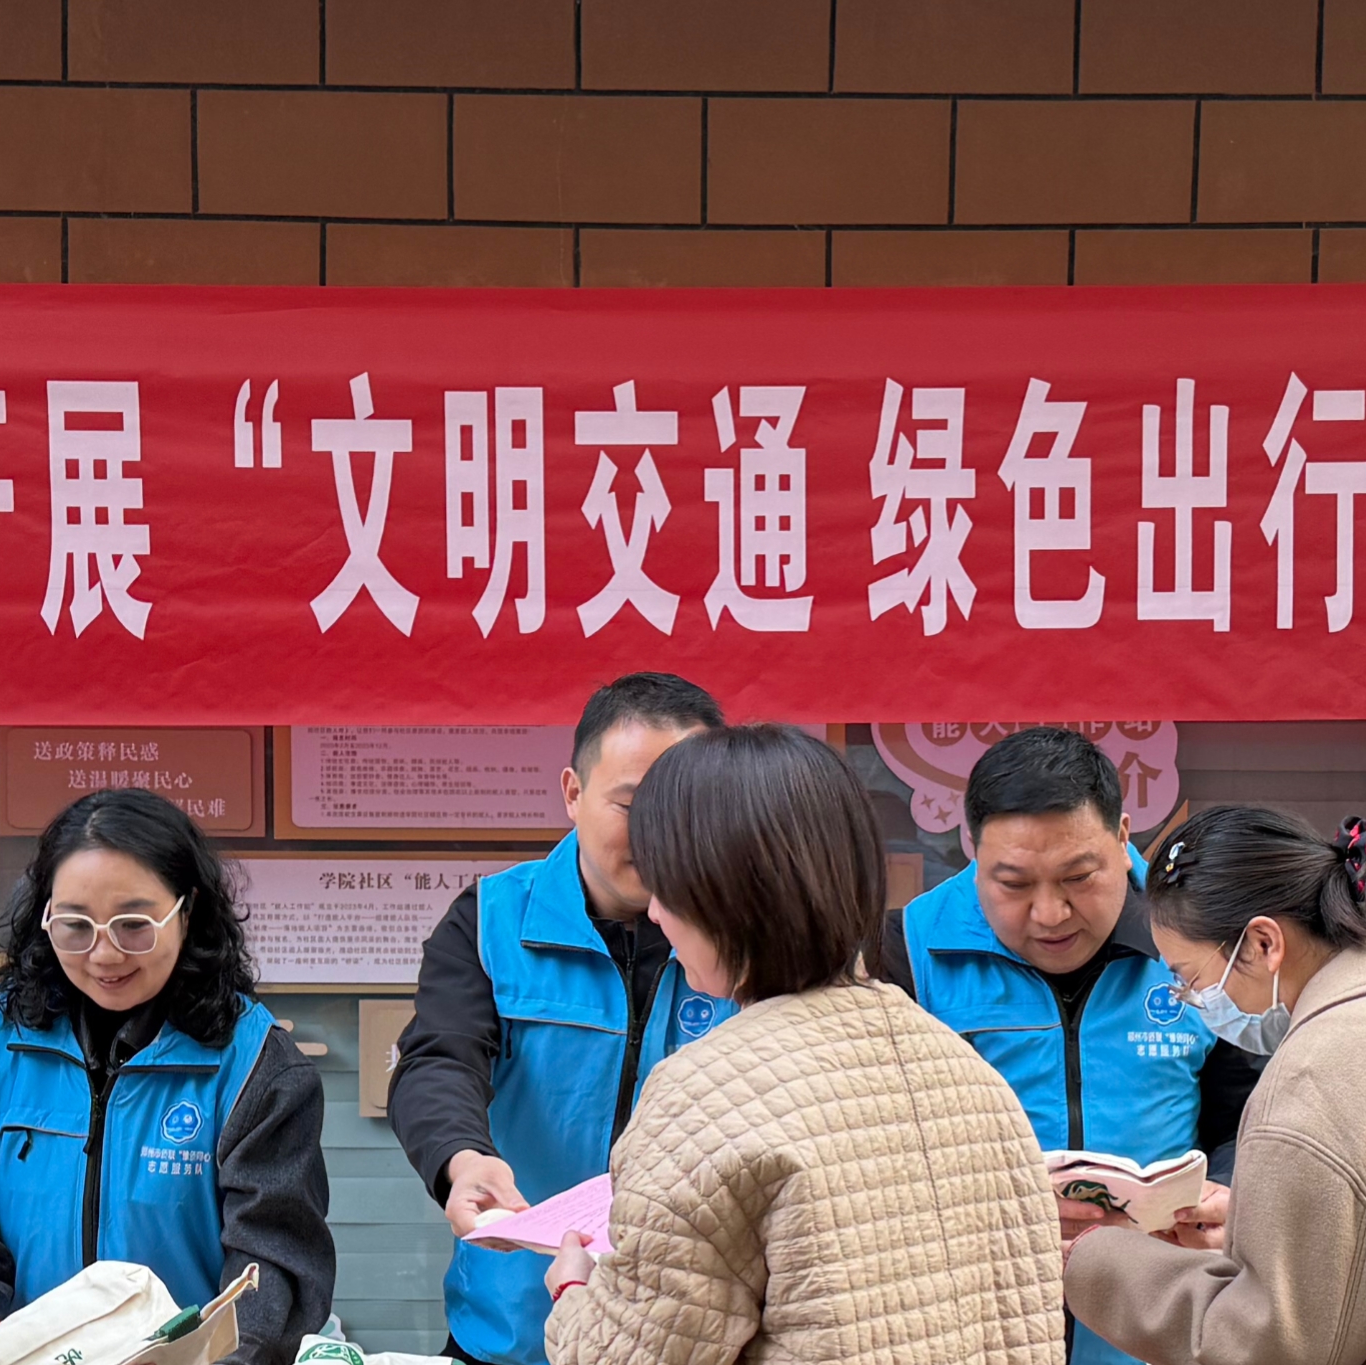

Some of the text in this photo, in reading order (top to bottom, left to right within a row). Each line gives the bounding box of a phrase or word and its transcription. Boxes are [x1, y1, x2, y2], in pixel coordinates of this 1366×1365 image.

[33, 741, 160, 761] 送政策释民惑
[68, 769, 193, 790] 送温暖聚民心
